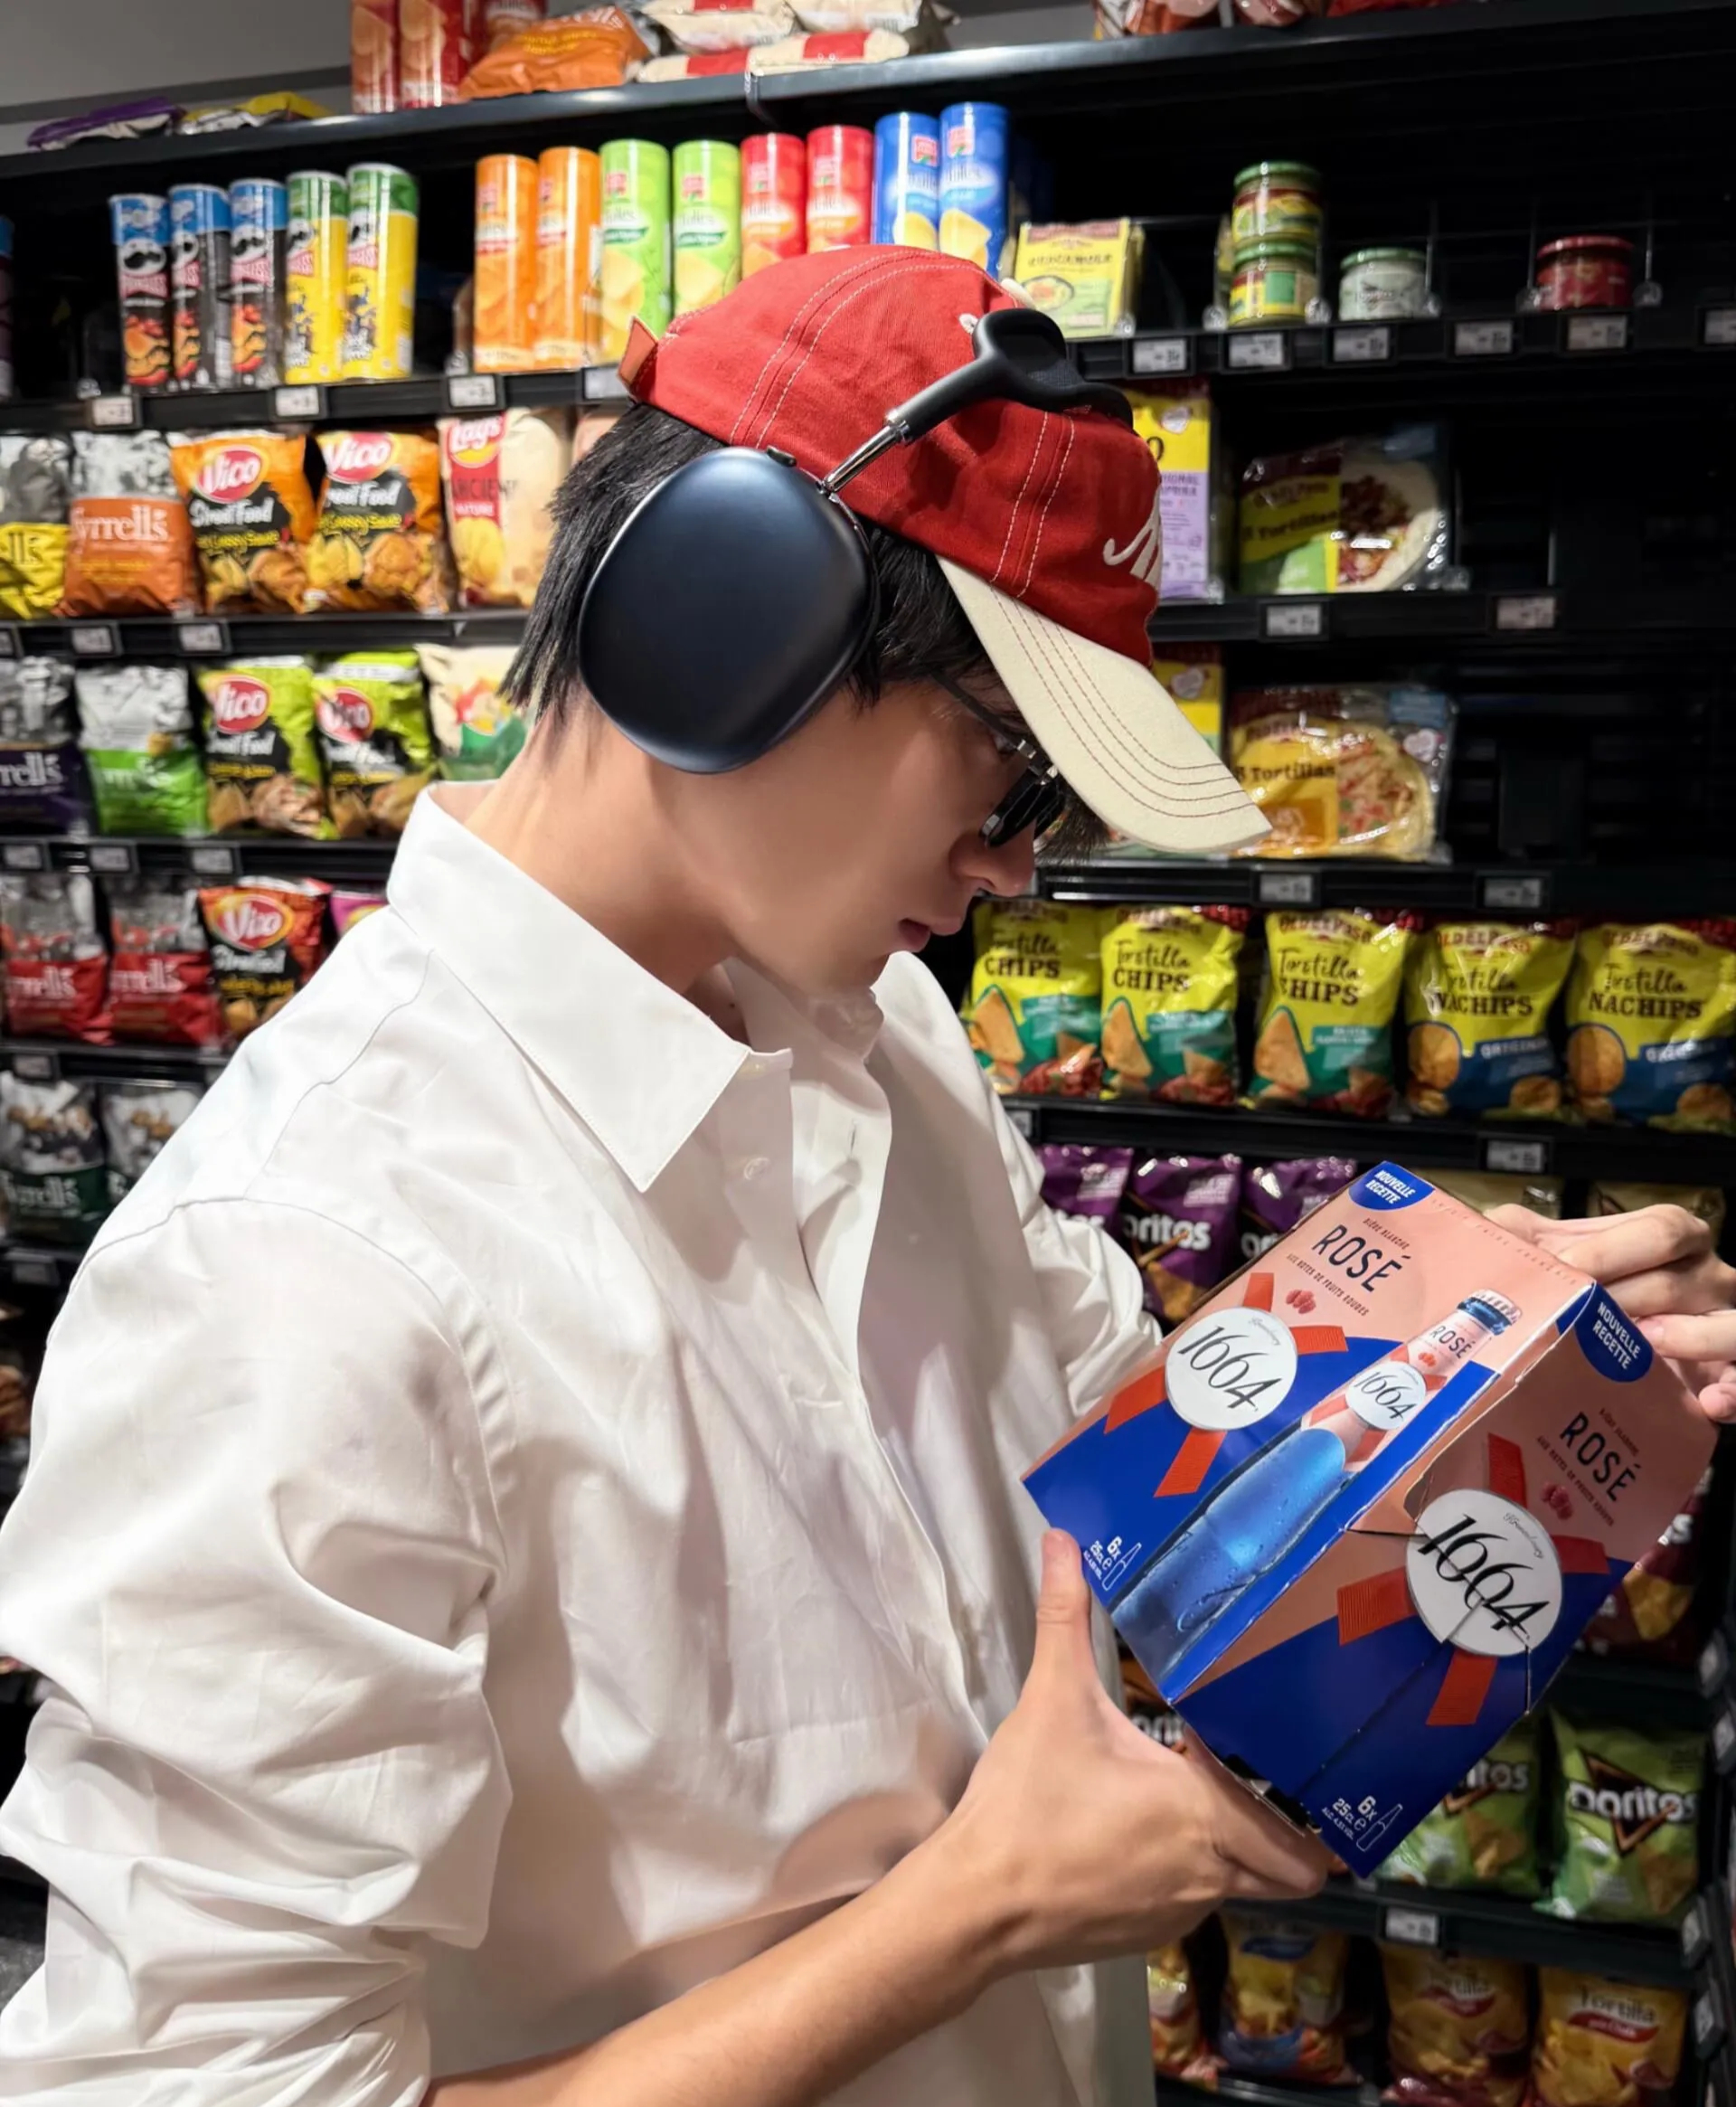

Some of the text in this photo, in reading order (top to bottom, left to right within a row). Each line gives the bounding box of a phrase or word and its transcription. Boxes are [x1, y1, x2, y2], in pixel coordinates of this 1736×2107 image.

[322, 438, 392, 472] Vico
[200, 452, 262, 495] Vico
[222, 902, 283, 942] Vico
[984, 958, 1061, 979] CHIPS
[1114, 940, 1191, 968] Tortilla
[1278, 947, 1360, 981] Tortilla
[1112, 967, 1191, 993] CHIPS
[1604, 963, 1686, 995] Tortilla
[1589, 990, 1703, 1020] NACHIPS
[1365, 1179, 1402, 1205] RECETTE
[1373, 1170, 1416, 1199] NOUVELLE
[1311, 1224, 1411, 1293] ROSÉ
[1320, 1277, 1344, 1299] FRUITS
[1429, 1326, 1476, 1359] ROSÉ
[1591, 1319, 1631, 1370] RECETTE
[1597, 1301, 1641, 1359] NOUVELLE
[1177, 1325, 1282, 1412] 1664
[1354, 1372, 1419, 1422] 1664
[1560, 1411, 1642, 1502] ROSÉ
[1418, 1513, 1551, 1640] 1664
[1569, 1779, 1697, 1822] Doritos
